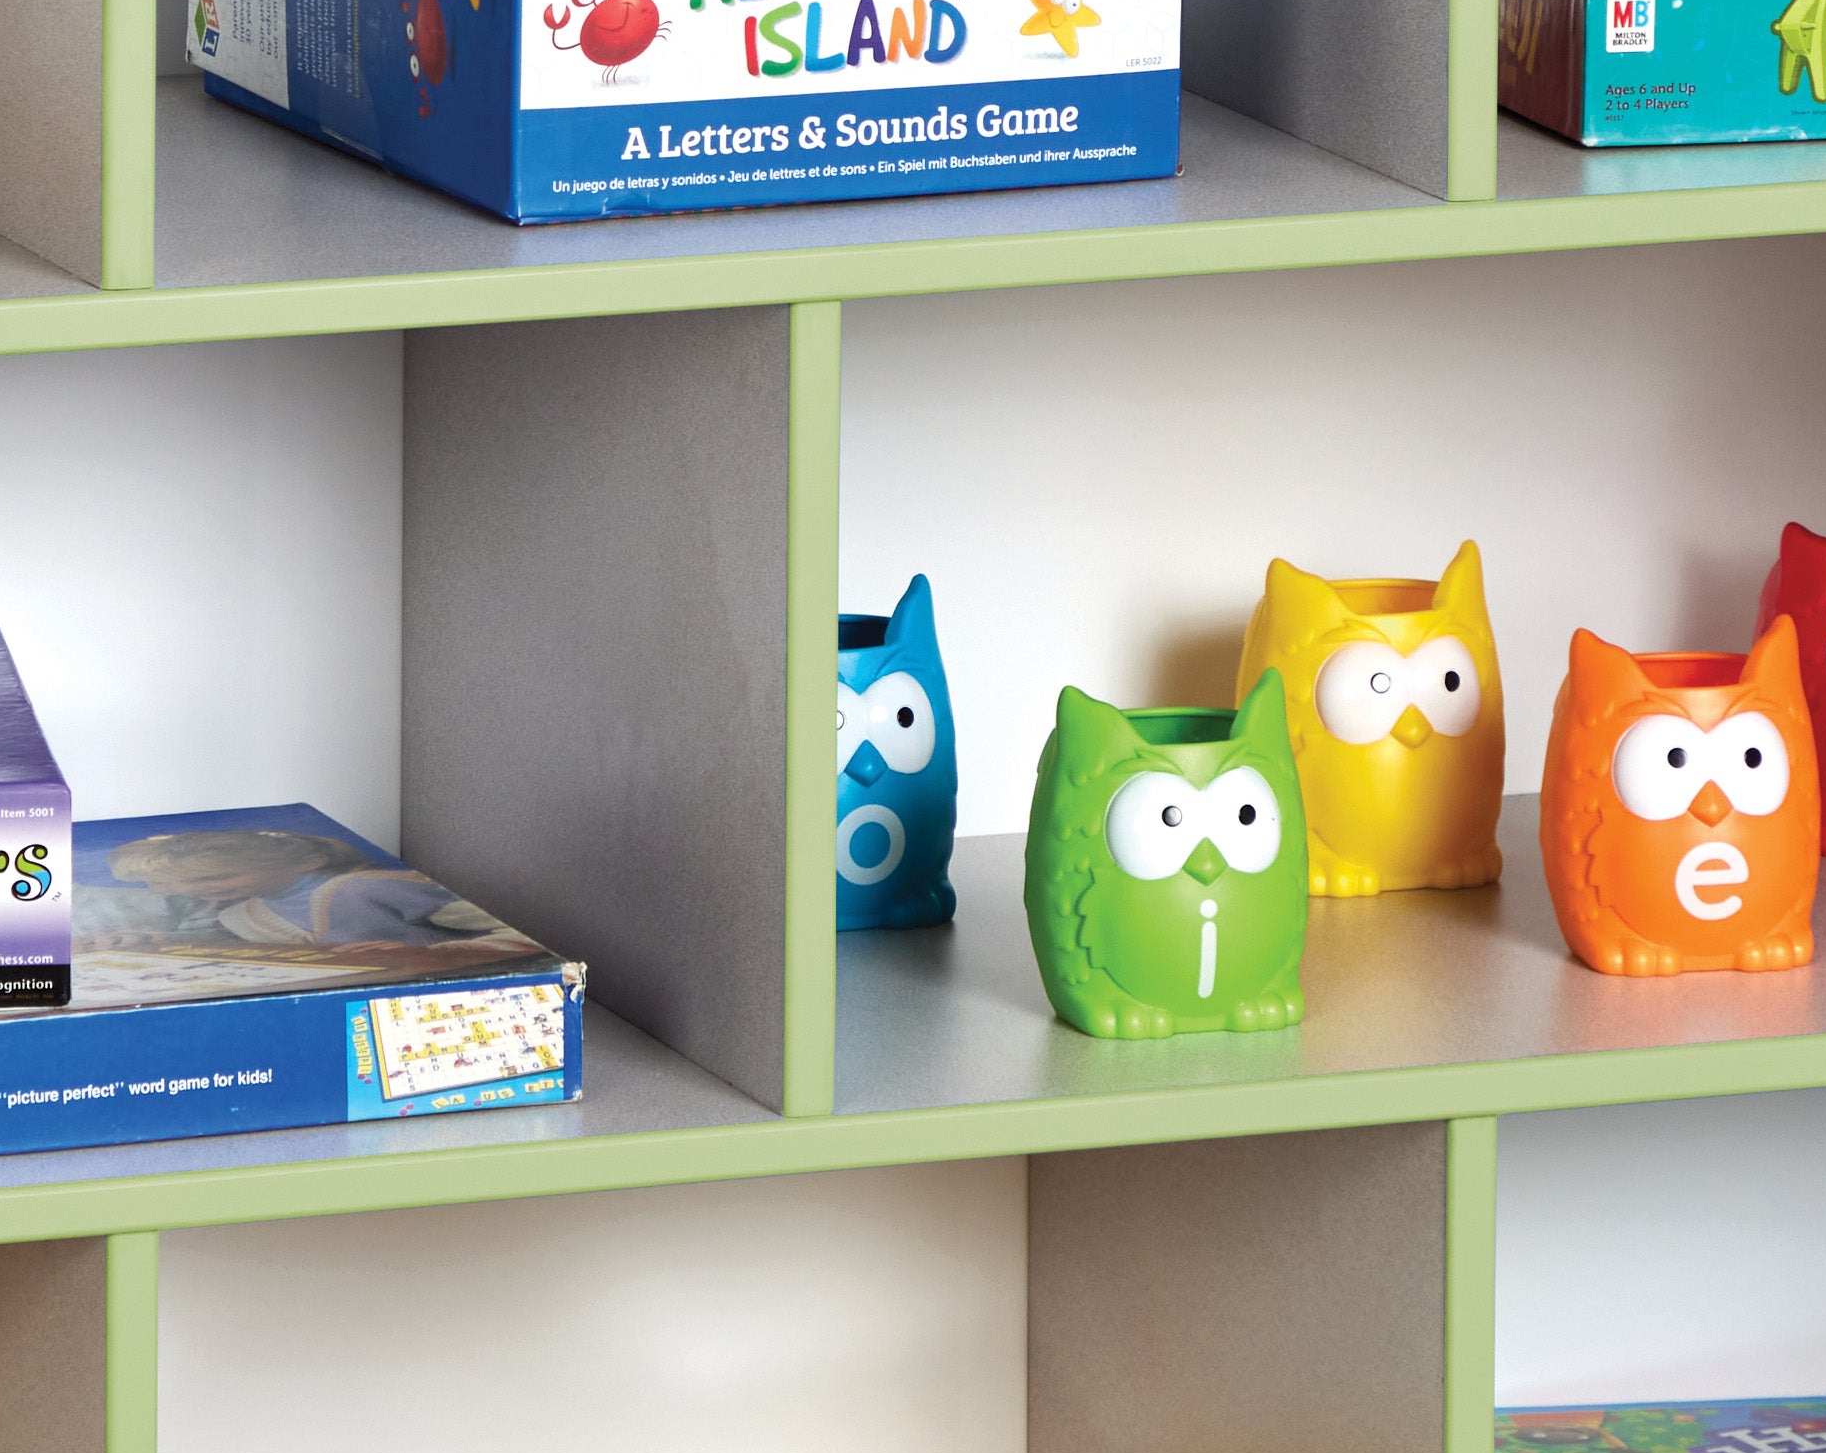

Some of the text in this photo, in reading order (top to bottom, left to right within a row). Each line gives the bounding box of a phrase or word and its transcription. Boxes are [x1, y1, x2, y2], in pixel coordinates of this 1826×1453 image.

[1613, 0, 1649, 28] MB
[1612, 38, 1648, 47] BRADLEY
[1126, 57, 1162, 67] LER 5022
[1605, 83, 1696, 98] Ages 6 and Up
[1605, 98, 1689, 113] 2 to 4 Players
[621, 105, 1079, 160] A Letters & Sounds Game
[553, 144, 1137, 194] Un juego de letras y sonidos Jeu de lettres et de sons Ein Spiel mit Buchstaben und ihrer Aussprache
[0, 807, 55, 819] Item 5001
[1674, 841, 1750, 921] e
[128, 1079, 165, 1095] word
[169, 1077, 209, 1095] game
[213, 1073, 234, 1087] for
[238, 1069, 272, 1085] kids!
